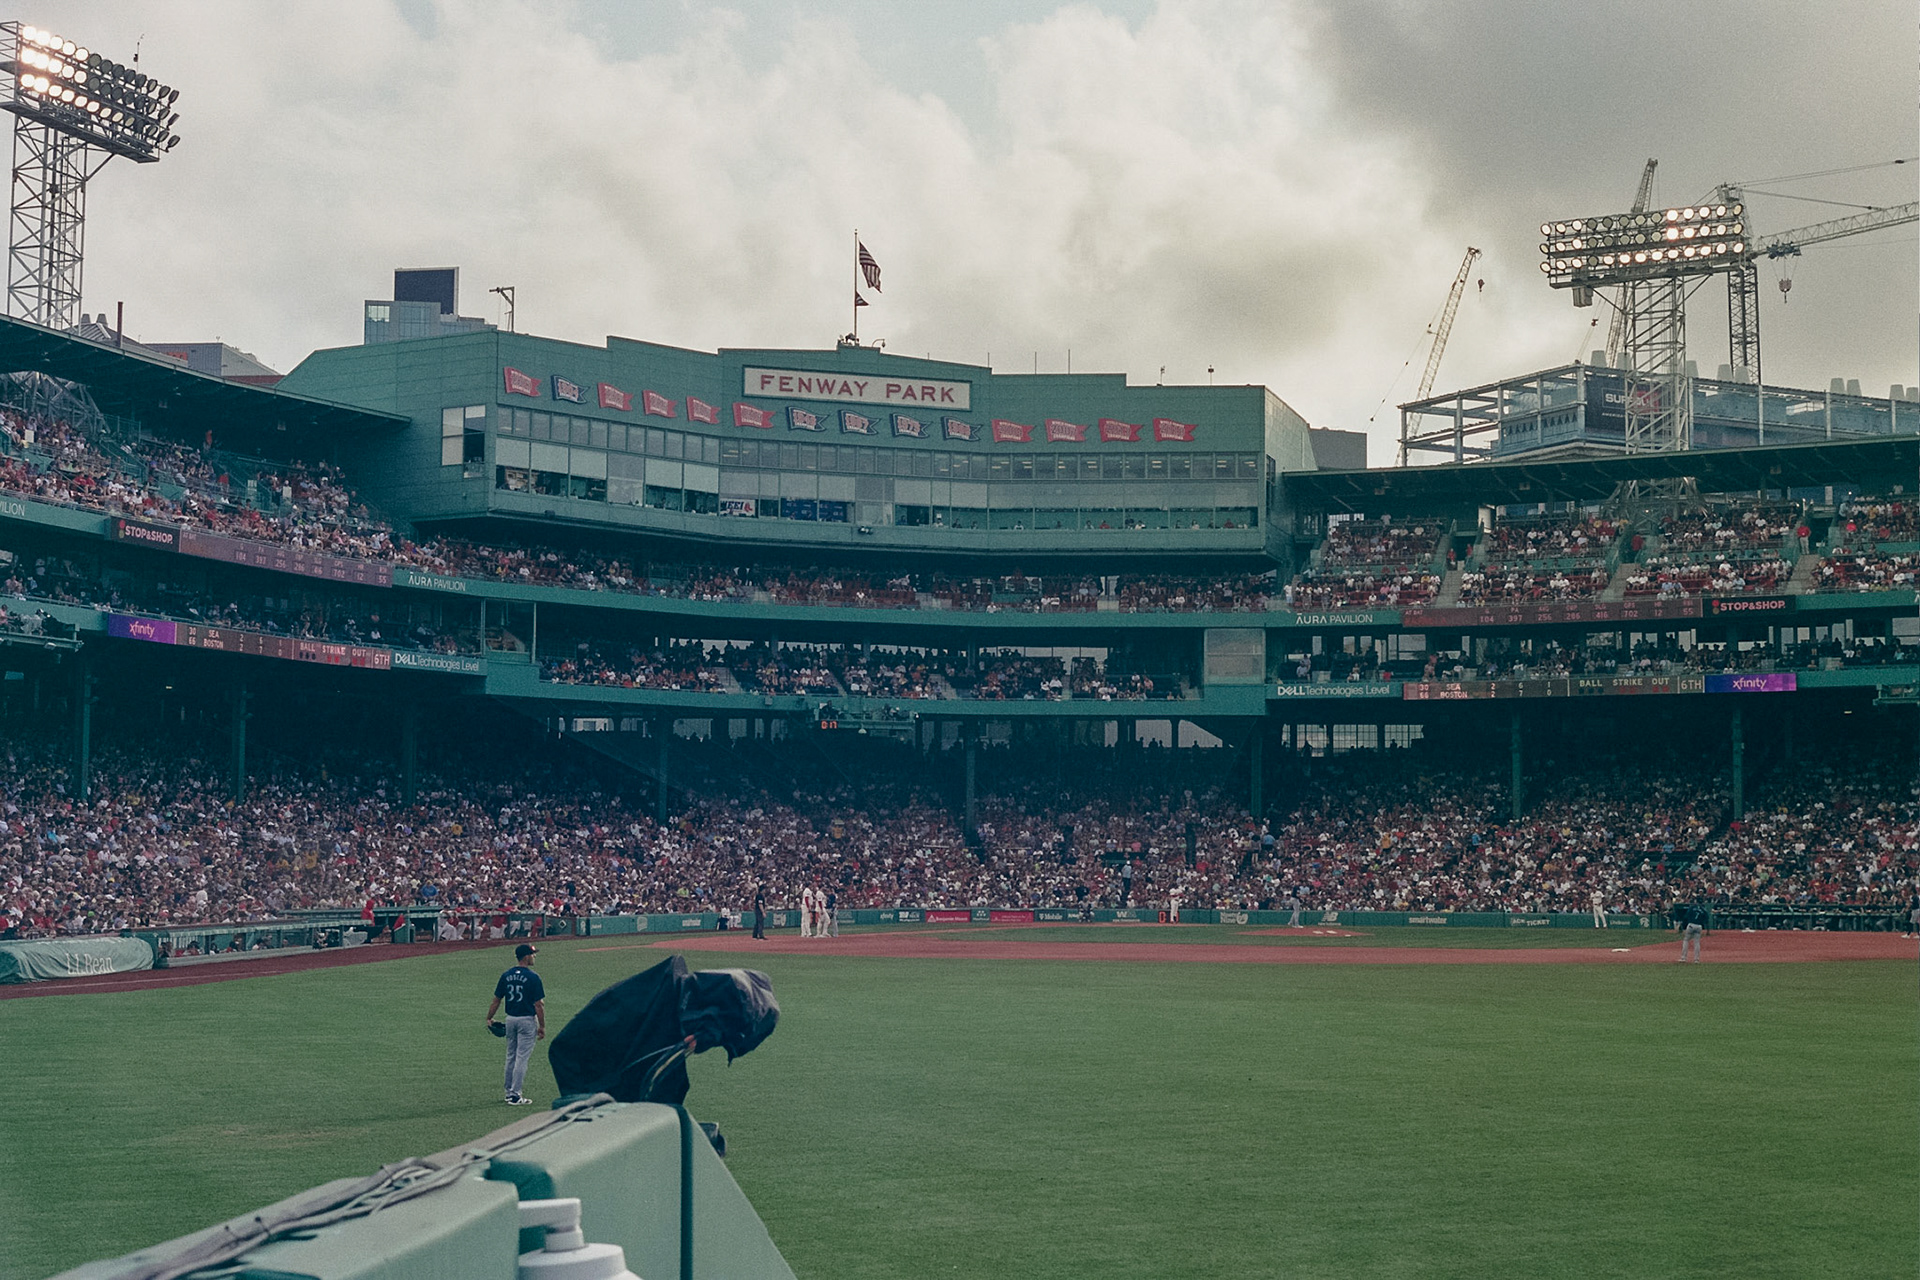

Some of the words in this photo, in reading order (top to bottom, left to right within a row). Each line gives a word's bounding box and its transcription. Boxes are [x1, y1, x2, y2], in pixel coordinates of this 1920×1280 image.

[761, 375, 868, 397] FENWAY
[886, 384, 955, 403] PARK
[0, 502, 25, 516] ILION
[379, 575, 386, 584] 55
[434, 578, 466, 591] PAVILION
[1330, 614, 1373, 624] PAVILION
[130, 622, 155, 638] xfinity
[208, 630, 220, 638] SEA
[240, 633, 244, 642] 2
[203, 638, 224, 649] BOSTON
[240, 643, 243, 652] 2
[300, 642, 315, 653] BALL
[322, 645, 346, 656] STRIKE
[352, 648, 366, 658] OUT
[374, 654, 390, 666] 6TH
[462, 660, 479, 671] Level
[1613, 678, 1643, 687] STRIKE
[1652, 677, 1670, 685] OUT
[1681, 680, 1702, 690] 6TH
[1733, 678, 1767, 690] xfinity
[1366, 685, 1390, 694] Level
[507, 984, 523, 1001] 35
